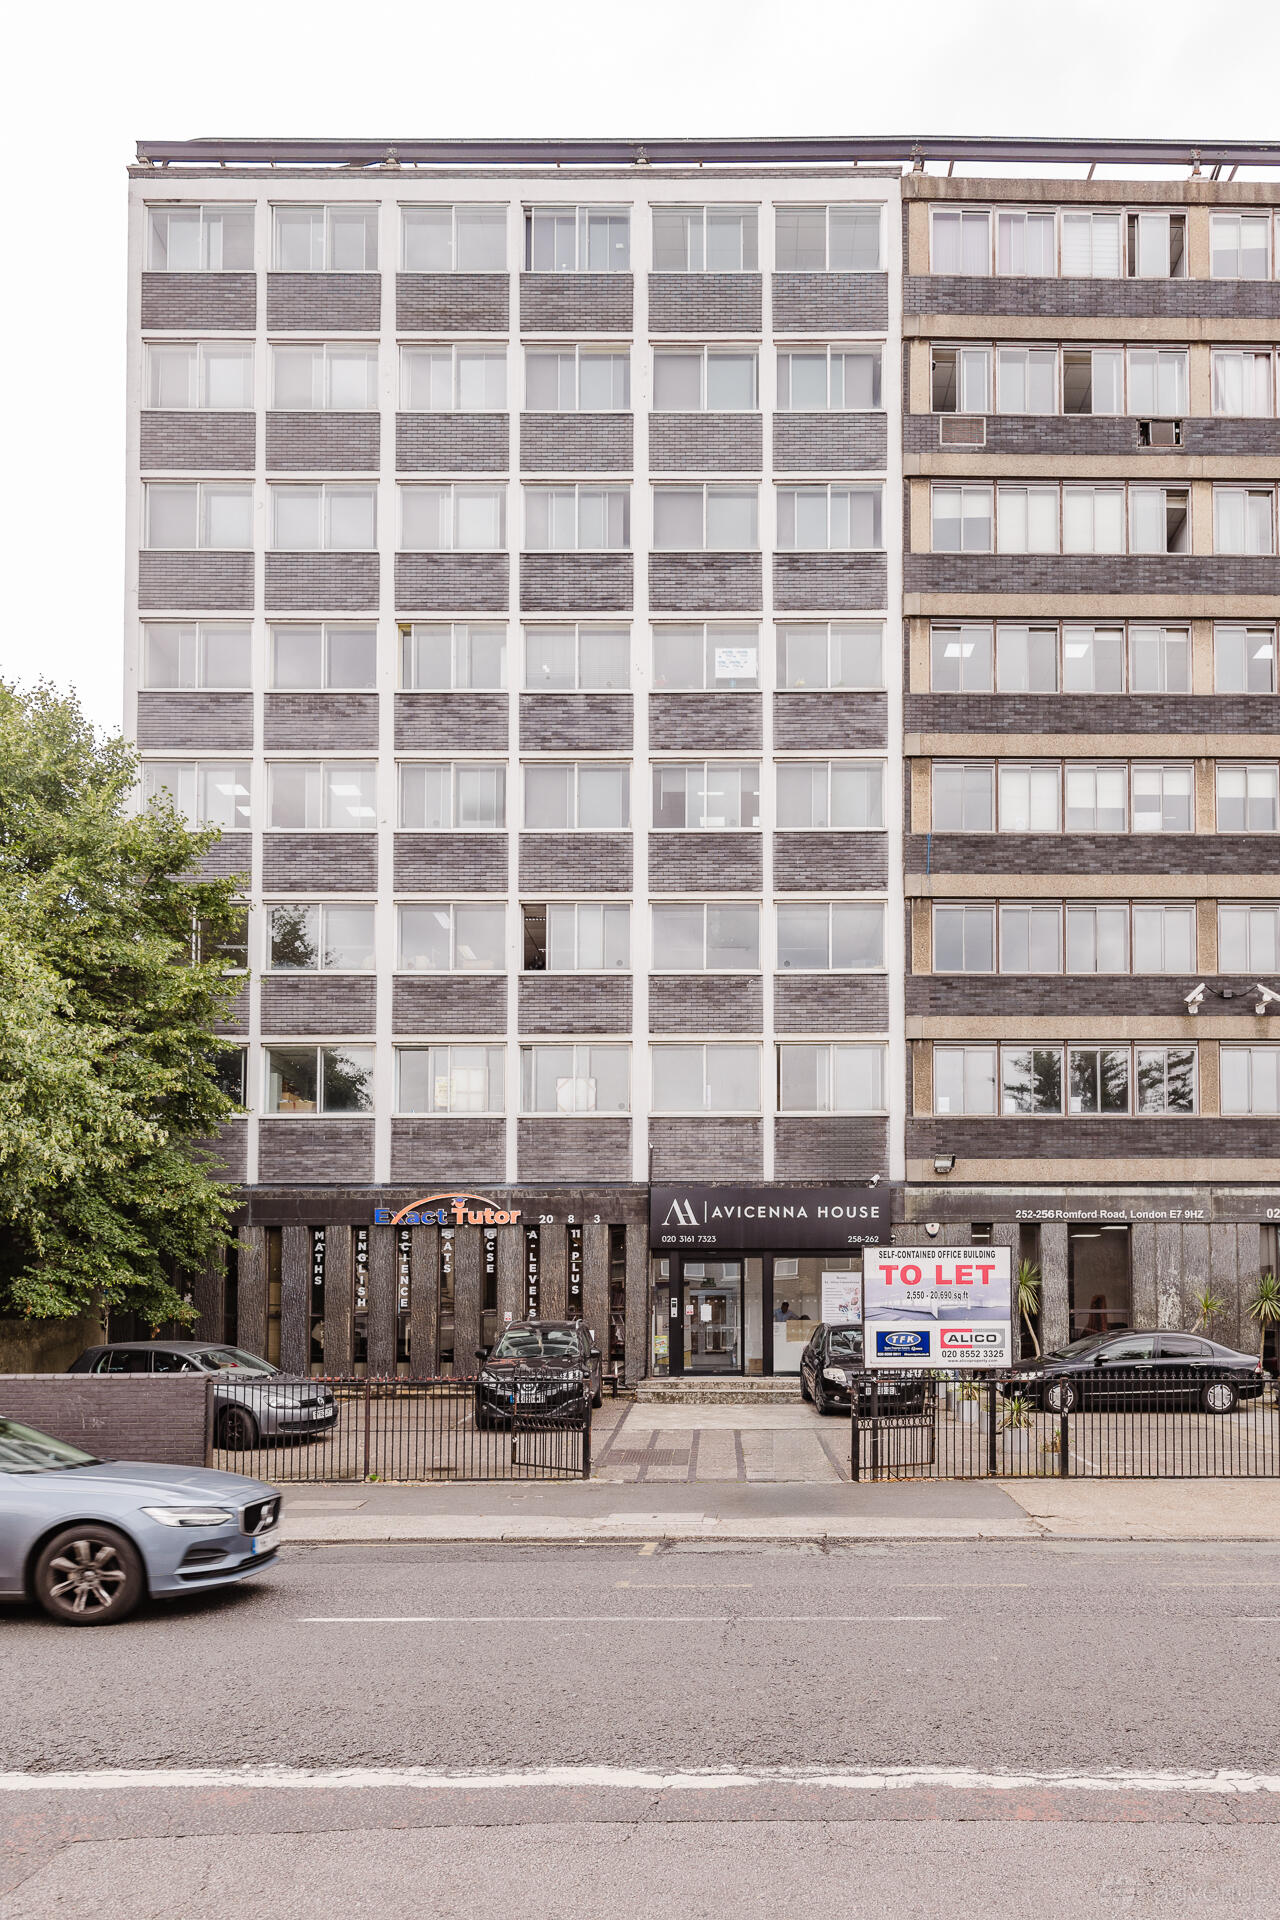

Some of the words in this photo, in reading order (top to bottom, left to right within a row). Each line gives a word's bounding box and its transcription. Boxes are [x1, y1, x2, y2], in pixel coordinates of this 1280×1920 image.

[374, 1207, 448, 1226] Exact
[451, 1207, 521, 1225] Tutor
[711, 1206, 808, 1218] AVICENNA
[817, 1206, 880, 1218] HOUSE
[1015, 1209, 1054, 1219] 252-256
[1056, 1209, 1097, 1219] Romford
[1100, 1209, 1127, 1220] Road,
[1130, 1209, 1166, 1219] London
[1170, 1209, 1182, 1219] E7
[1184, 1209, 1204, 1219] 9HZ
[539, 1214, 554, 1224] 20
[567, 1214, 575, 1224] 8
[593, 1214, 601, 1224] 3
[661, 1235, 677, 1243] 020
[679, 1235, 695, 1243] 3161
[697, 1235, 717, 1243] 7323
[847, 1235, 879, 1243] 258-262
[443, 1230, 452, 1273] SATS
[486, 1230, 495, 1273] GCSE
[878, 1250, 936, 1259] SELF-CONTAINED
[937, 1250, 961, 1259] OFFICE
[963, 1250, 996, 1259] BUILDING
[314, 1231, 324, 1285] MATHS
[571, 1229, 580, 1295] 11-PLUS
[357, 1230, 367, 1307] ENGLISH
[400, 1231, 409, 1308] SCIENCE
[528, 1230, 538, 1317] A-LEVELS
[879, 1264, 922, 1285] TO
[935, 1264, 996, 1285] LET
[906, 1291, 925, 1300] 2,550
[953, 1292, 961, 1301] sq
[962, 1291, 969, 1299] ft
[892, 1335, 915, 1343] TFK
[948, 1334, 997, 1342] ALICO
[941, 1350, 957, 1358] 020
[960, 1350, 981, 1358] 8552
[983, 1350, 1004, 1358] 3325
